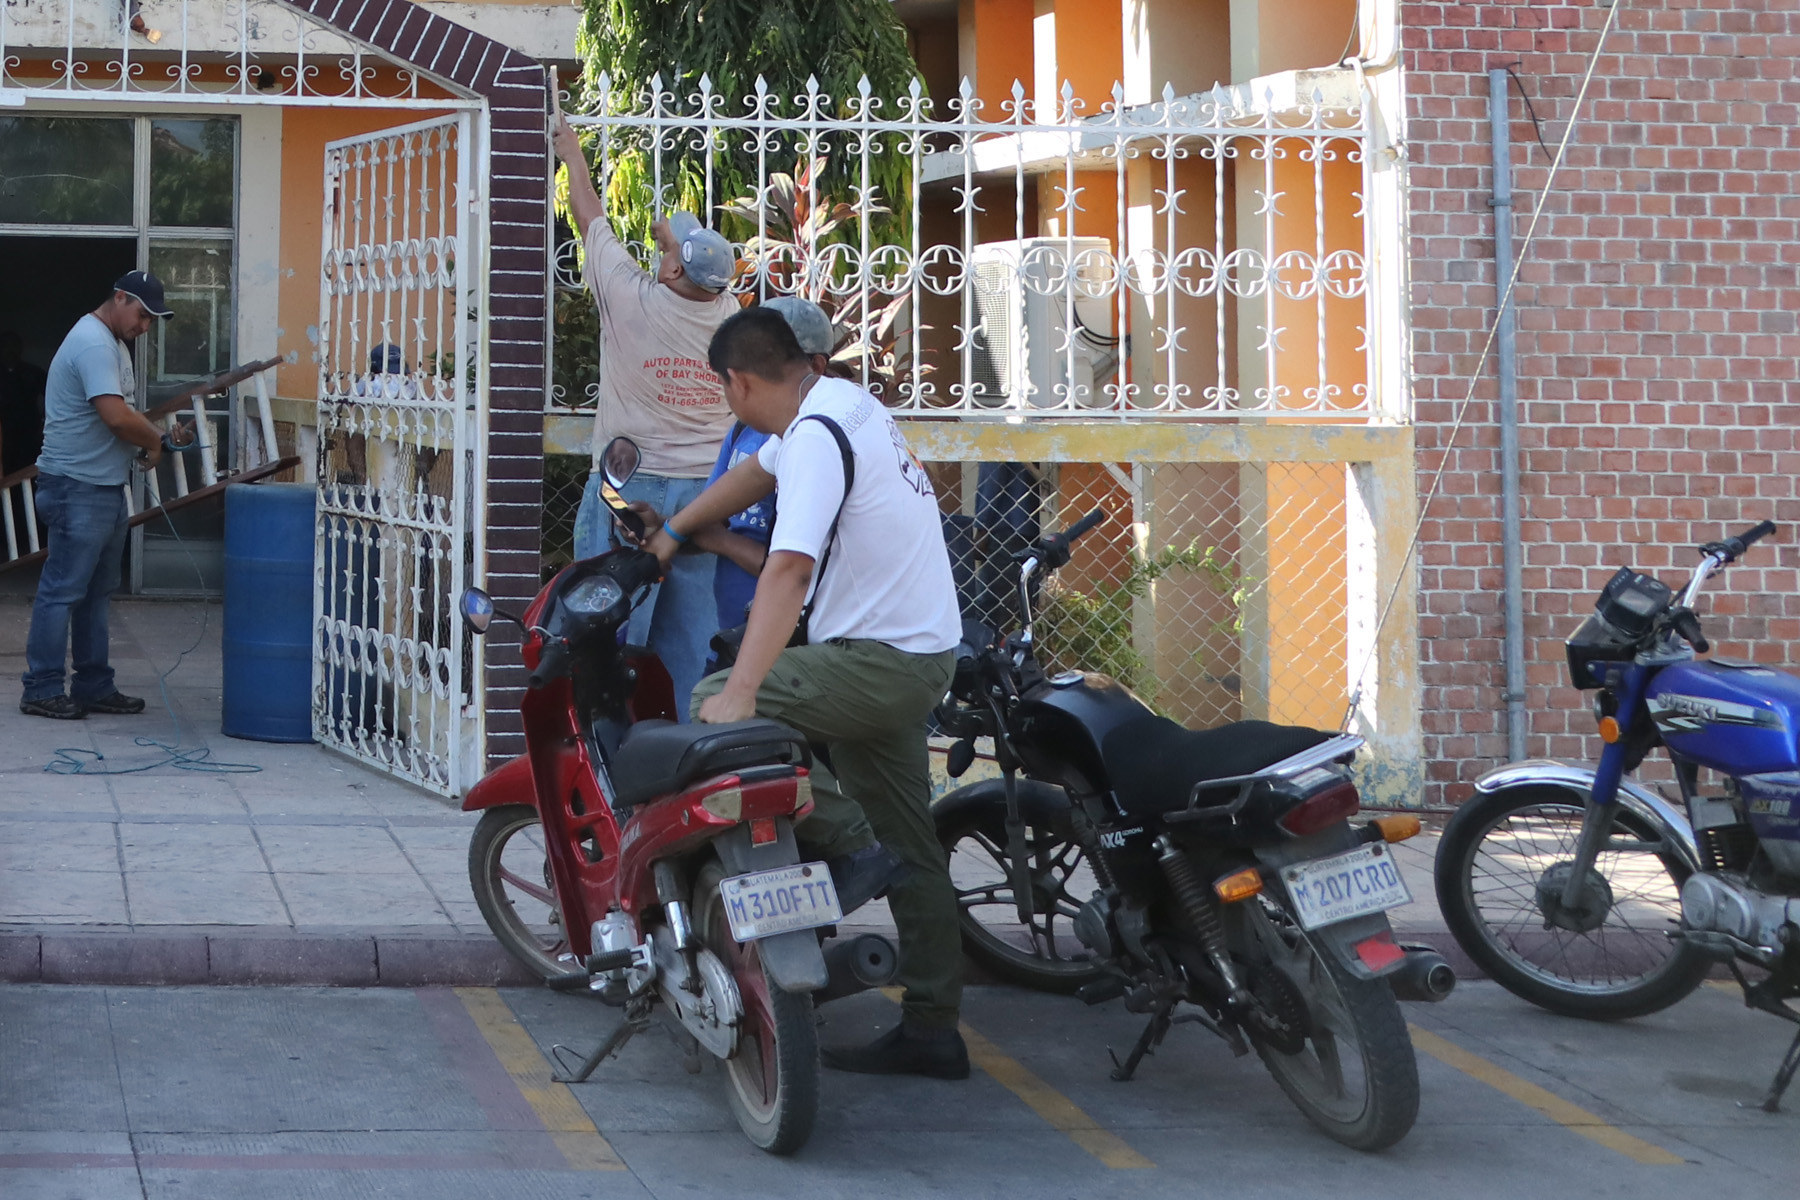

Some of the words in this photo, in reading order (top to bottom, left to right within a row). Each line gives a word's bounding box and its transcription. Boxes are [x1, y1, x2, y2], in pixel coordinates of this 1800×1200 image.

[644, 357, 671, 368] AUTO
[673, 357, 703, 369] PARTS
[656, 369, 669, 378] OF
[672, 369, 691, 378] BAY
[1656, 692, 1718, 720] SUZUKI
